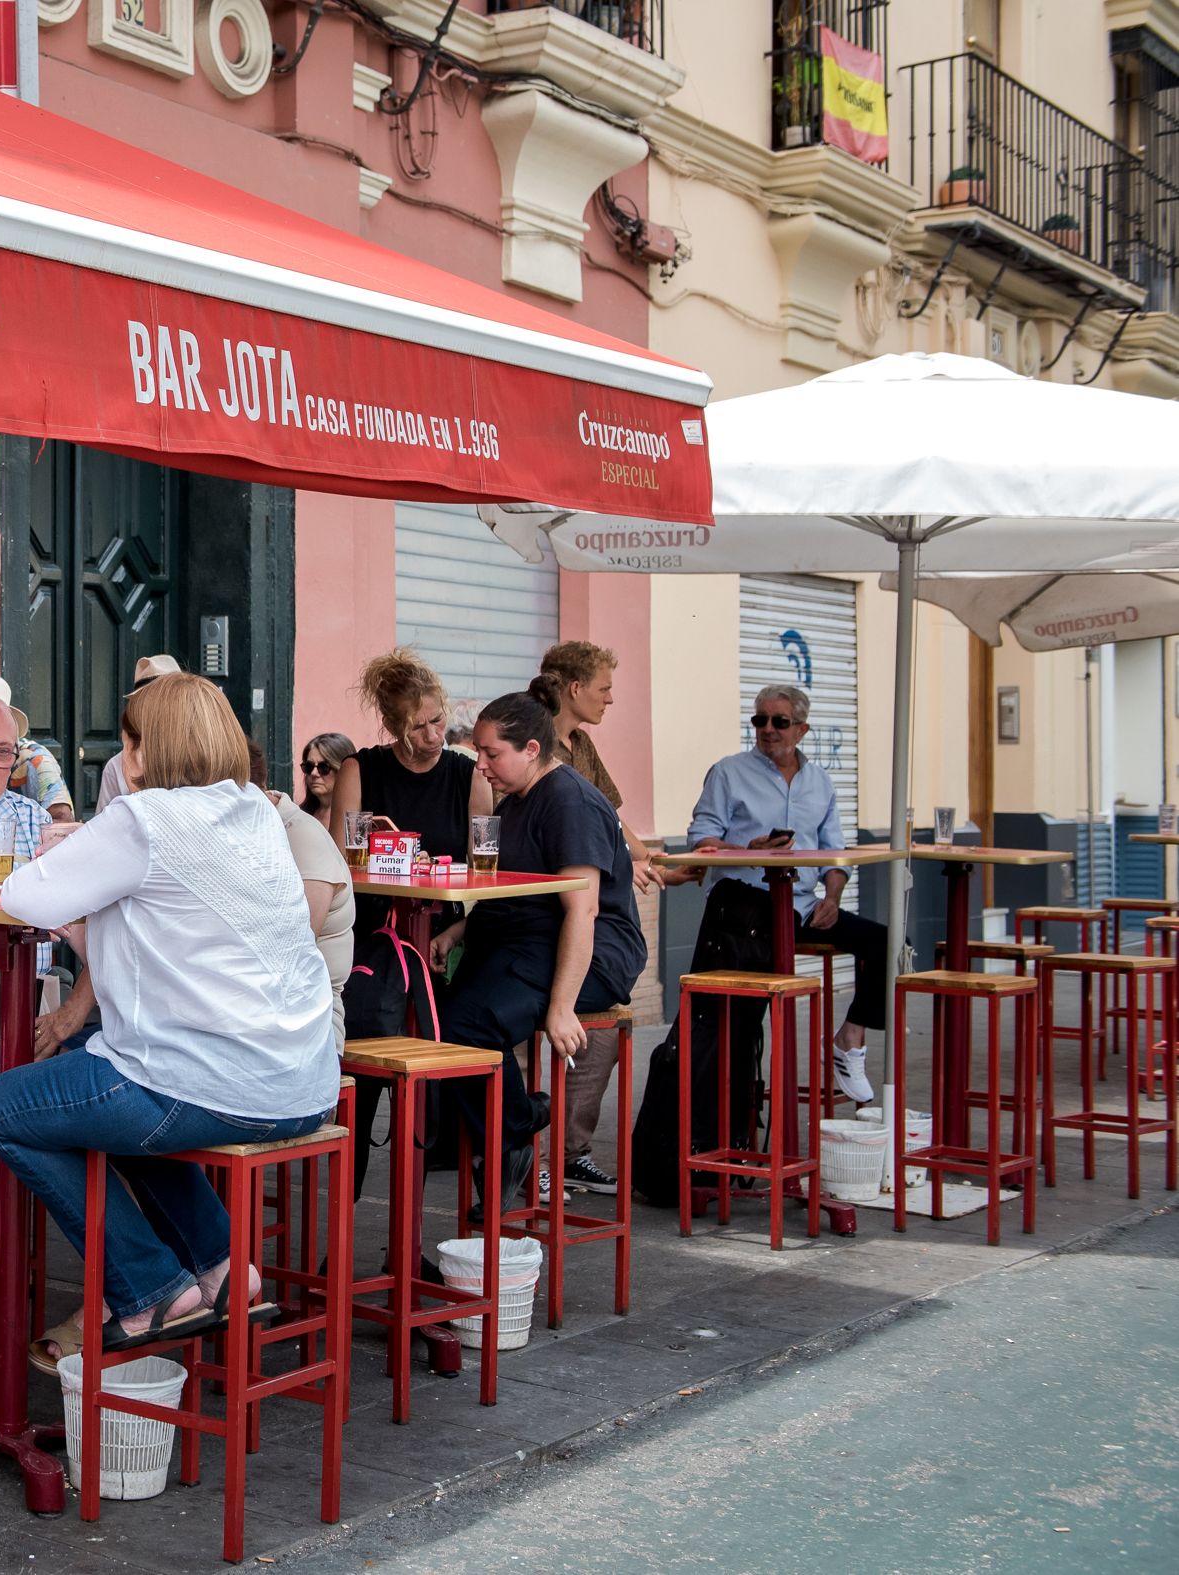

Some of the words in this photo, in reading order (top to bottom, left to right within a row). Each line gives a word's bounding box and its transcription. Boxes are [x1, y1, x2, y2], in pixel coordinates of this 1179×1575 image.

[127, 319, 210, 412] BAR
[218, 338, 302, 429] JOTA
[305, 394, 351, 437] CASA
[354, 403, 430, 447] FUNDADA
[430, 416, 453, 451] EN
[453, 417, 500, 461] 1.936
[578, 409, 671, 464] Cruzcampo
[601, 461, 660, 490] ESPECIAL
[376, 855, 405, 865] Fumar
[379, 866, 401, 874] mata
